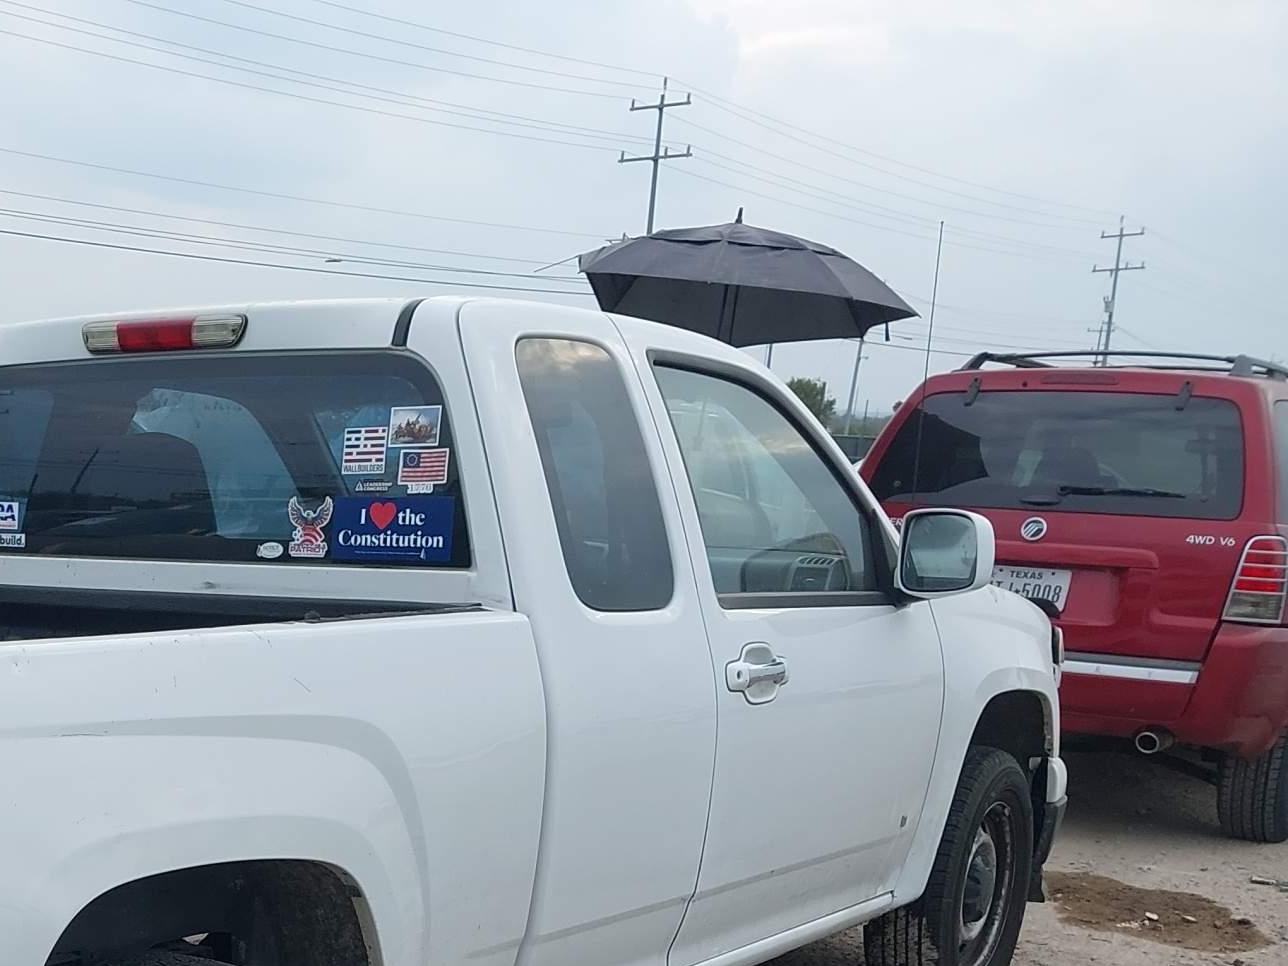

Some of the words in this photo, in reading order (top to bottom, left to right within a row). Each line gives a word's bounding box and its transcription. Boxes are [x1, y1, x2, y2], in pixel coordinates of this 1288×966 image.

[343, 464, 384, 473] WALLBUILDERS
[359, 508, 367, 524] I
[397, 508, 426, 525] the
[338, 529, 444, 548] Constitution
[1185, 534, 1215, 545] 4WD
[1219, 536, 1236, 547] V6
[290, 543, 326, 554] PATRIOT
[1010, 570, 1043, 580] TEXAS
